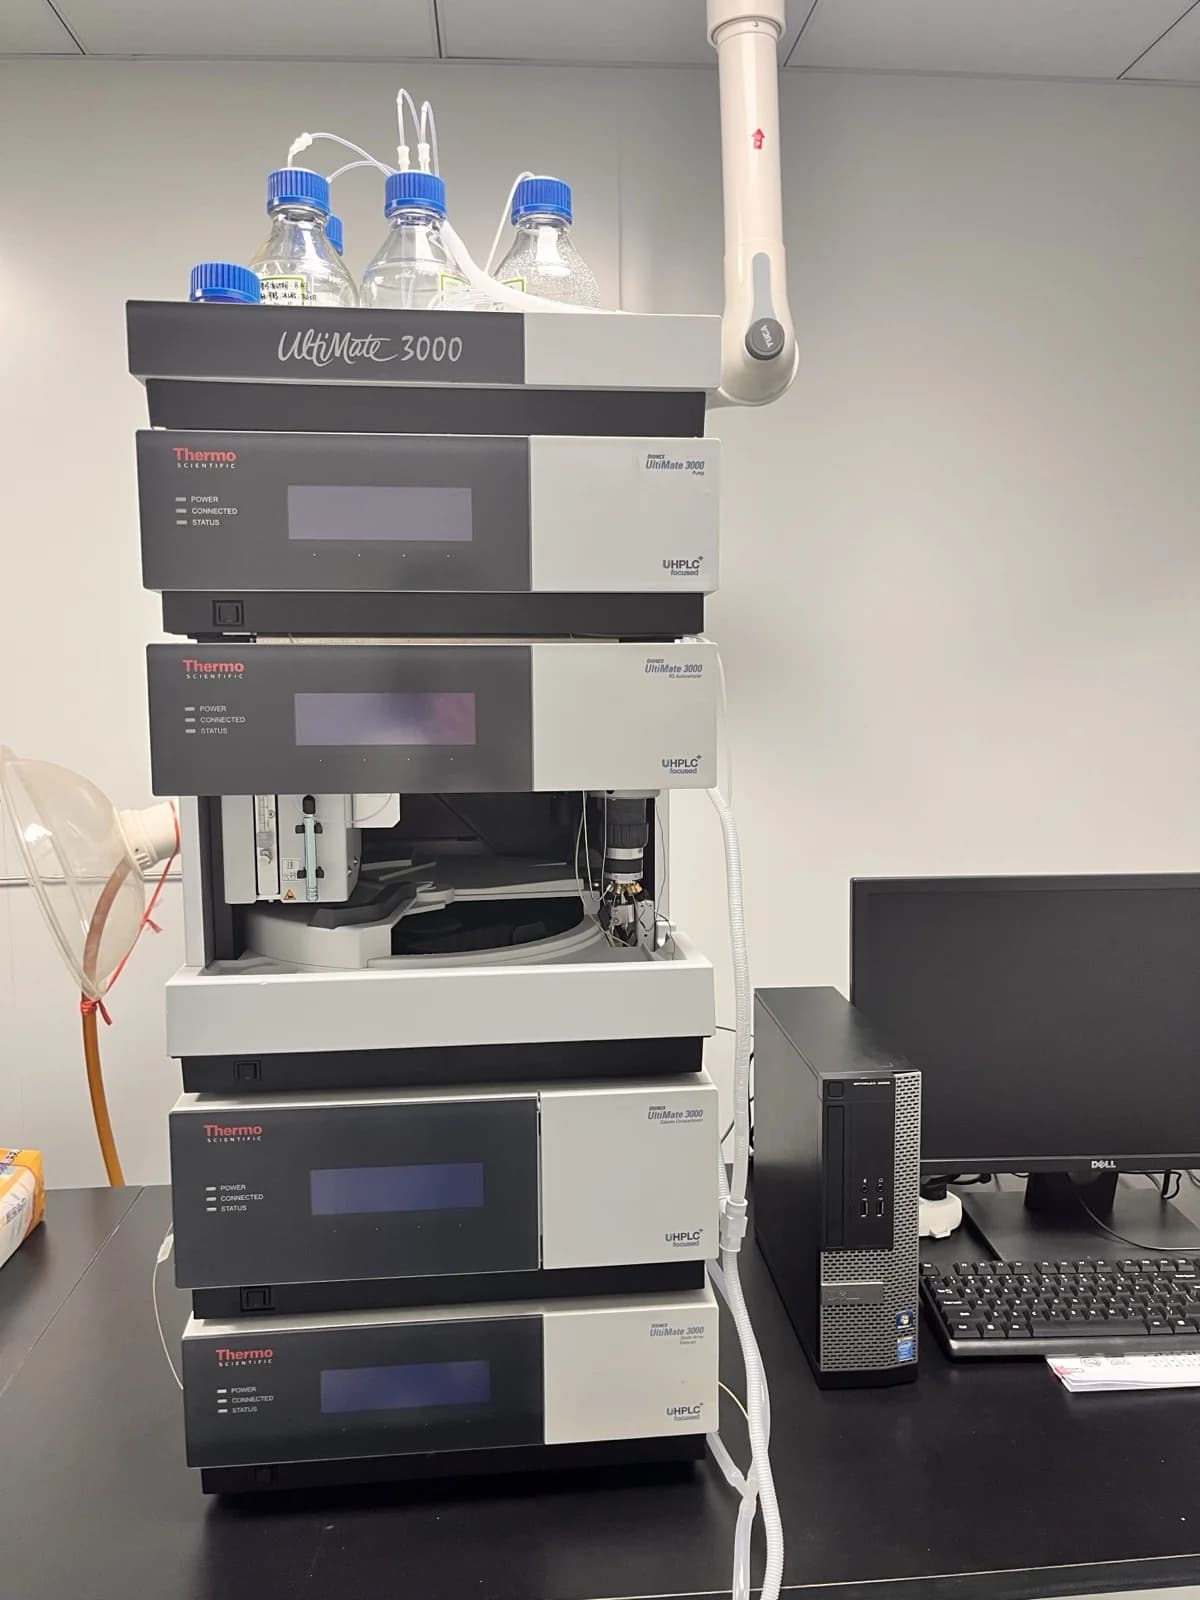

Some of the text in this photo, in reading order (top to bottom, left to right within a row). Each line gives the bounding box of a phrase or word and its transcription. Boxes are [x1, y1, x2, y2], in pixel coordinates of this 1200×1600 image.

[278, 328, 463, 367] UltiMate 3000
[172, 447, 237, 462] Thermo
[646, 460, 705, 470] UltiMate 3000
[191, 507, 239, 515] CONNECTED
[192, 519, 220, 527] STATUS
[182, 659, 245, 673] Thermo
[645, 664, 703, 673] UltiMate 3000
[199, 705, 227, 713] POWER
[200, 716, 246, 724] CONNECTED
[200, 727, 228, 735] STATUS
[648, 1109, 704, 1120] UltiMate 3000
[203, 1124, 263, 1137] Thermo
[1091, 1160, 1117, 1169] DELL
[220, 1184, 246, 1192] POWER
[220, 1193, 264, 1202] CONNECTED
[686, 1326, 704, 1335] 3000
[215, 1348, 273, 1361] Thermo
[218, 1359, 273, 1367] SCIENTIFIC
[231, 1386, 257, 1394] POWER
[231, 1395, 274, 1404] CONNECTED
[232, 1406, 258, 1414] STATUS
